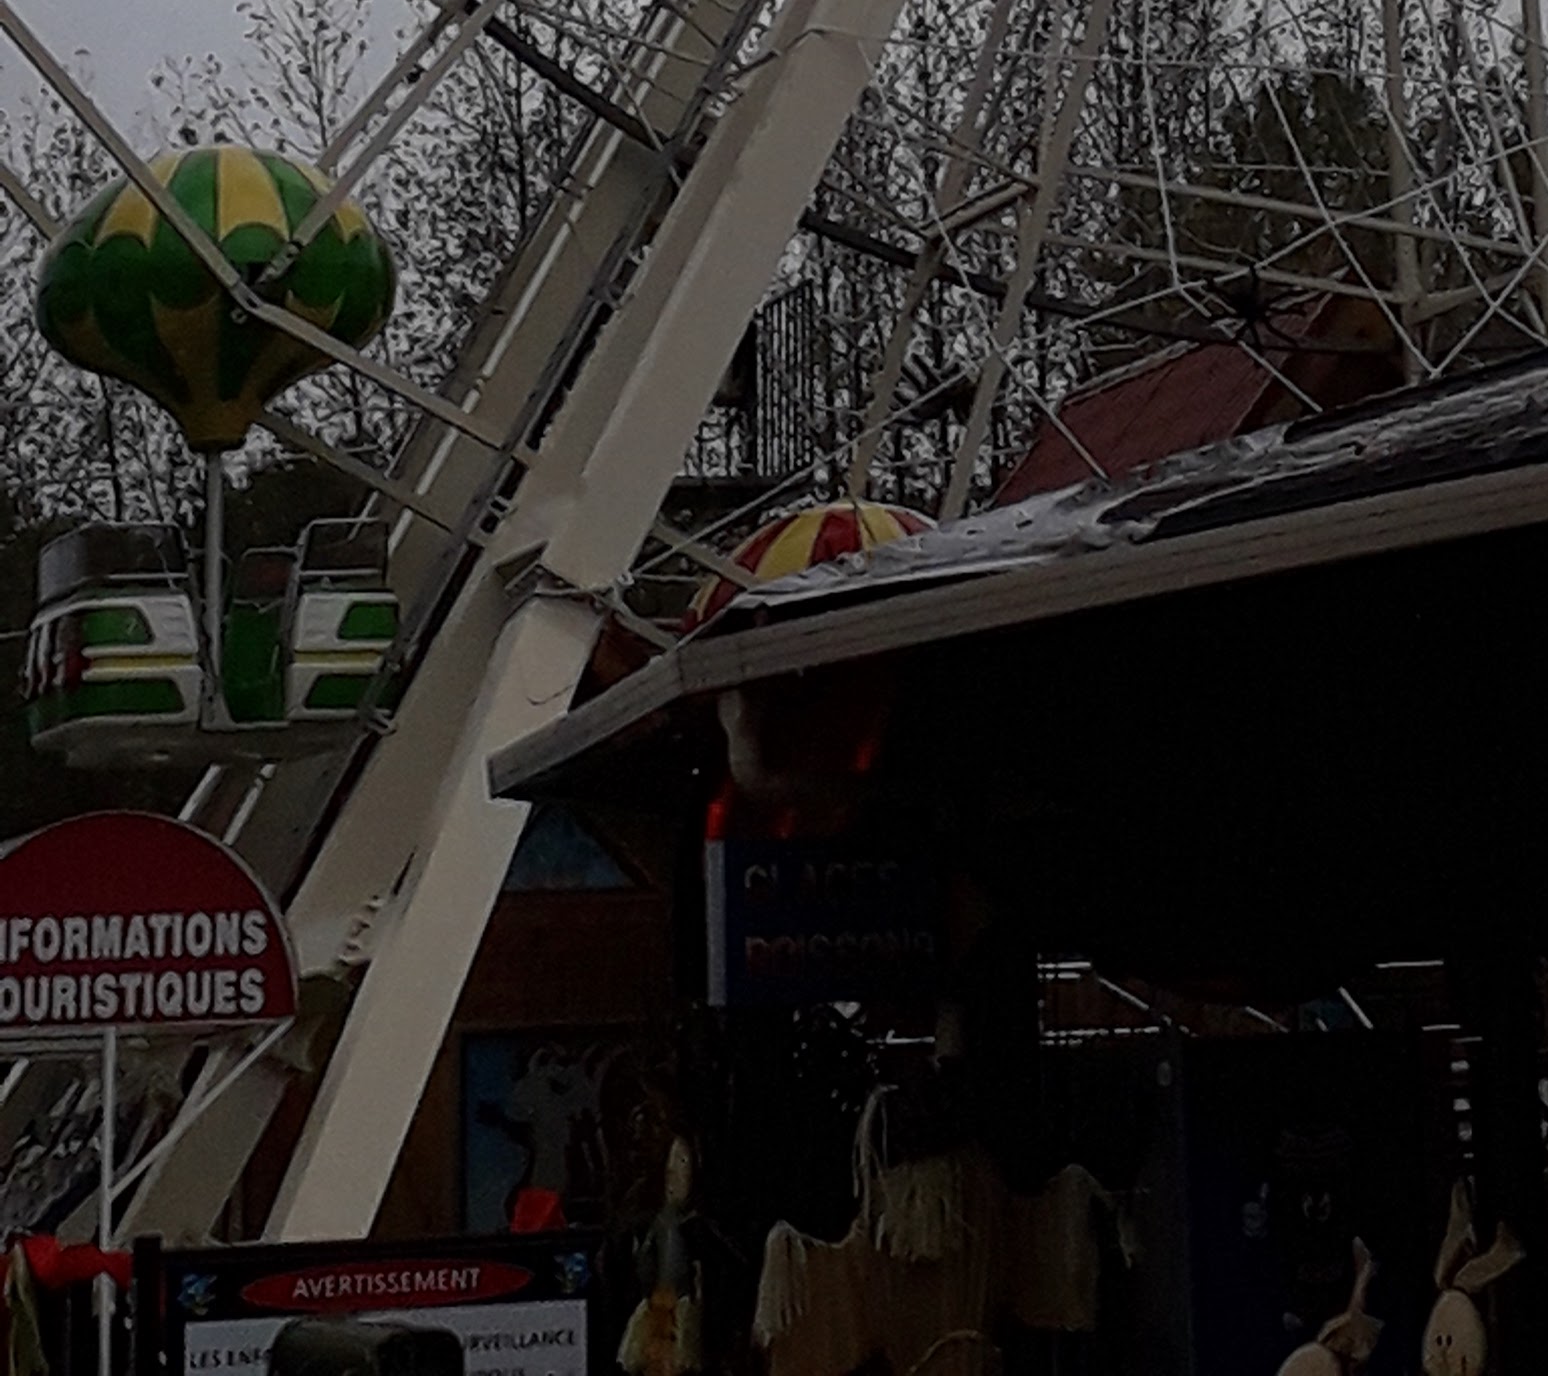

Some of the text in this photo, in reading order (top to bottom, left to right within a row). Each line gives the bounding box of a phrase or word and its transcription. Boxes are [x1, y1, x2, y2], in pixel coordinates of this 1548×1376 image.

[0, 909, 268, 964] FORMATIONS
[0, 967, 266, 1023] OURISTIQUES
[291, 1267, 481, 1300] AVERTISSEMENT
